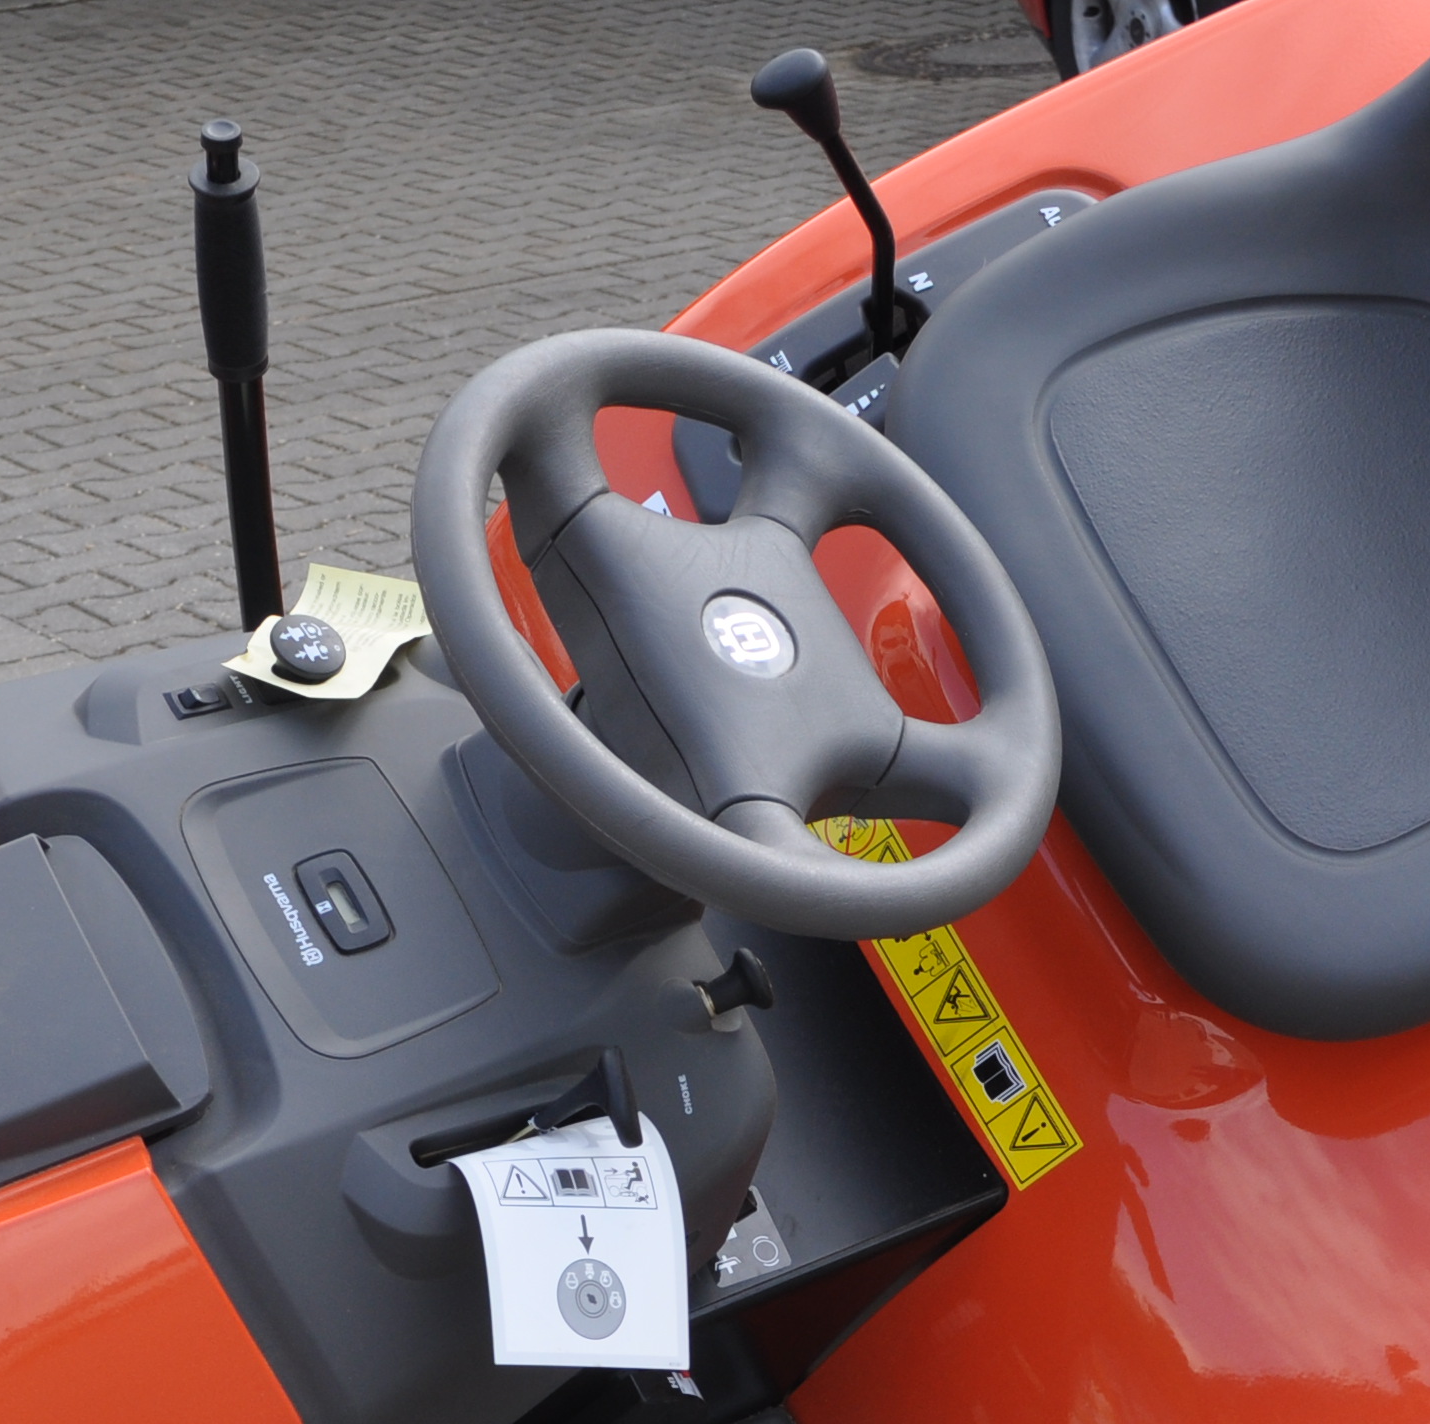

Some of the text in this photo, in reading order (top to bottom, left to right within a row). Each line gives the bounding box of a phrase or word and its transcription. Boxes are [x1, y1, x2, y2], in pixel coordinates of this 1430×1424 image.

[907, 271, 934, 292] N
[229, 675, 253, 704] LIGHT
[263, 872, 314, 950] Husqvarna
[677, 1073, 693, 1115] CHOKE
